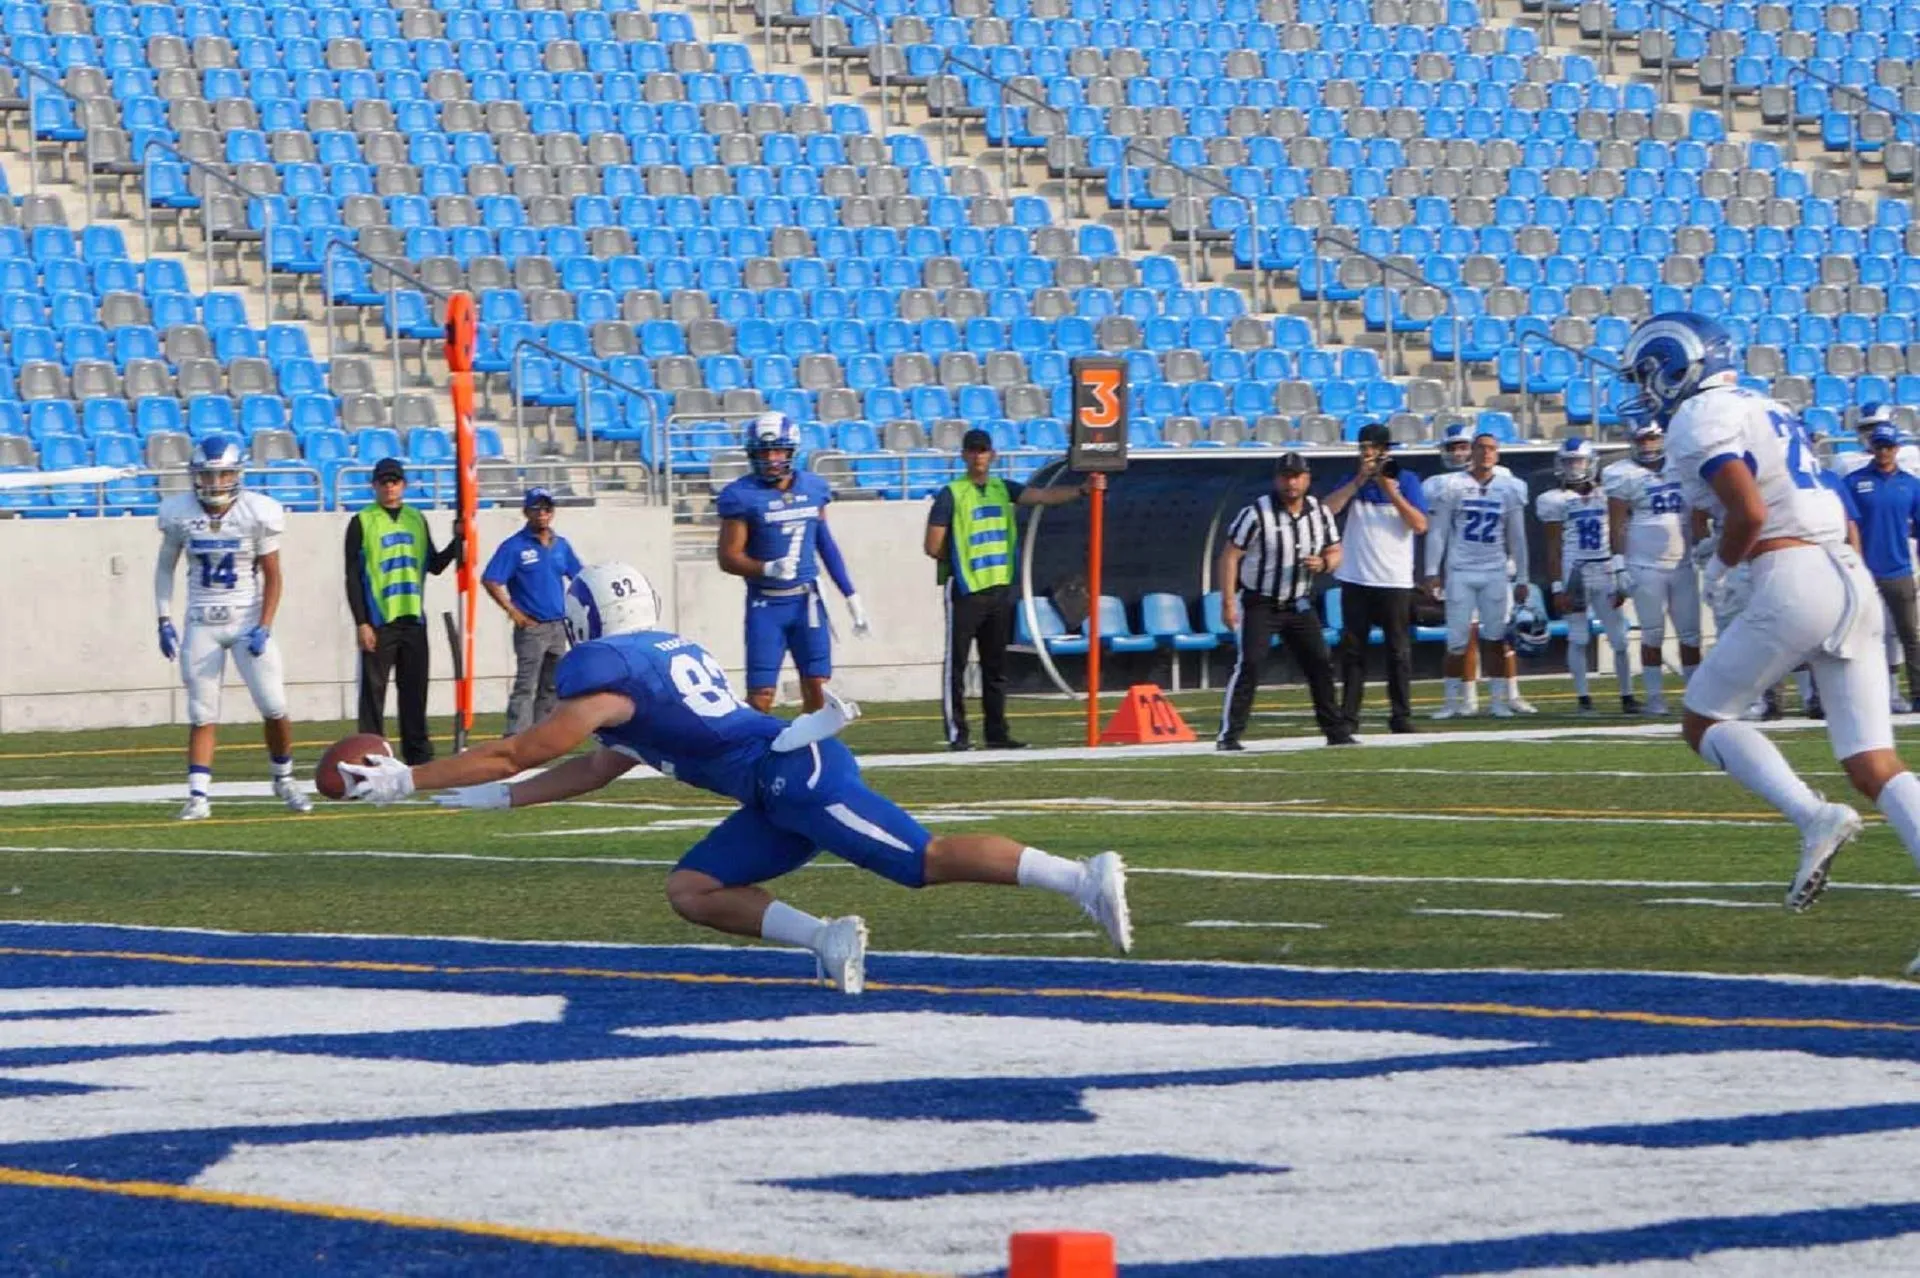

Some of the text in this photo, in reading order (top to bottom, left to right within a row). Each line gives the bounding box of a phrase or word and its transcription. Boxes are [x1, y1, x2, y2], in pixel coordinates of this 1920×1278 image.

[1080, 369, 1119, 428] 3
[782, 520, 807, 561] 7
[1464, 510, 1499, 543] 22
[199, 551, 238, 589] 14
[611, 577, 637, 598] 82
